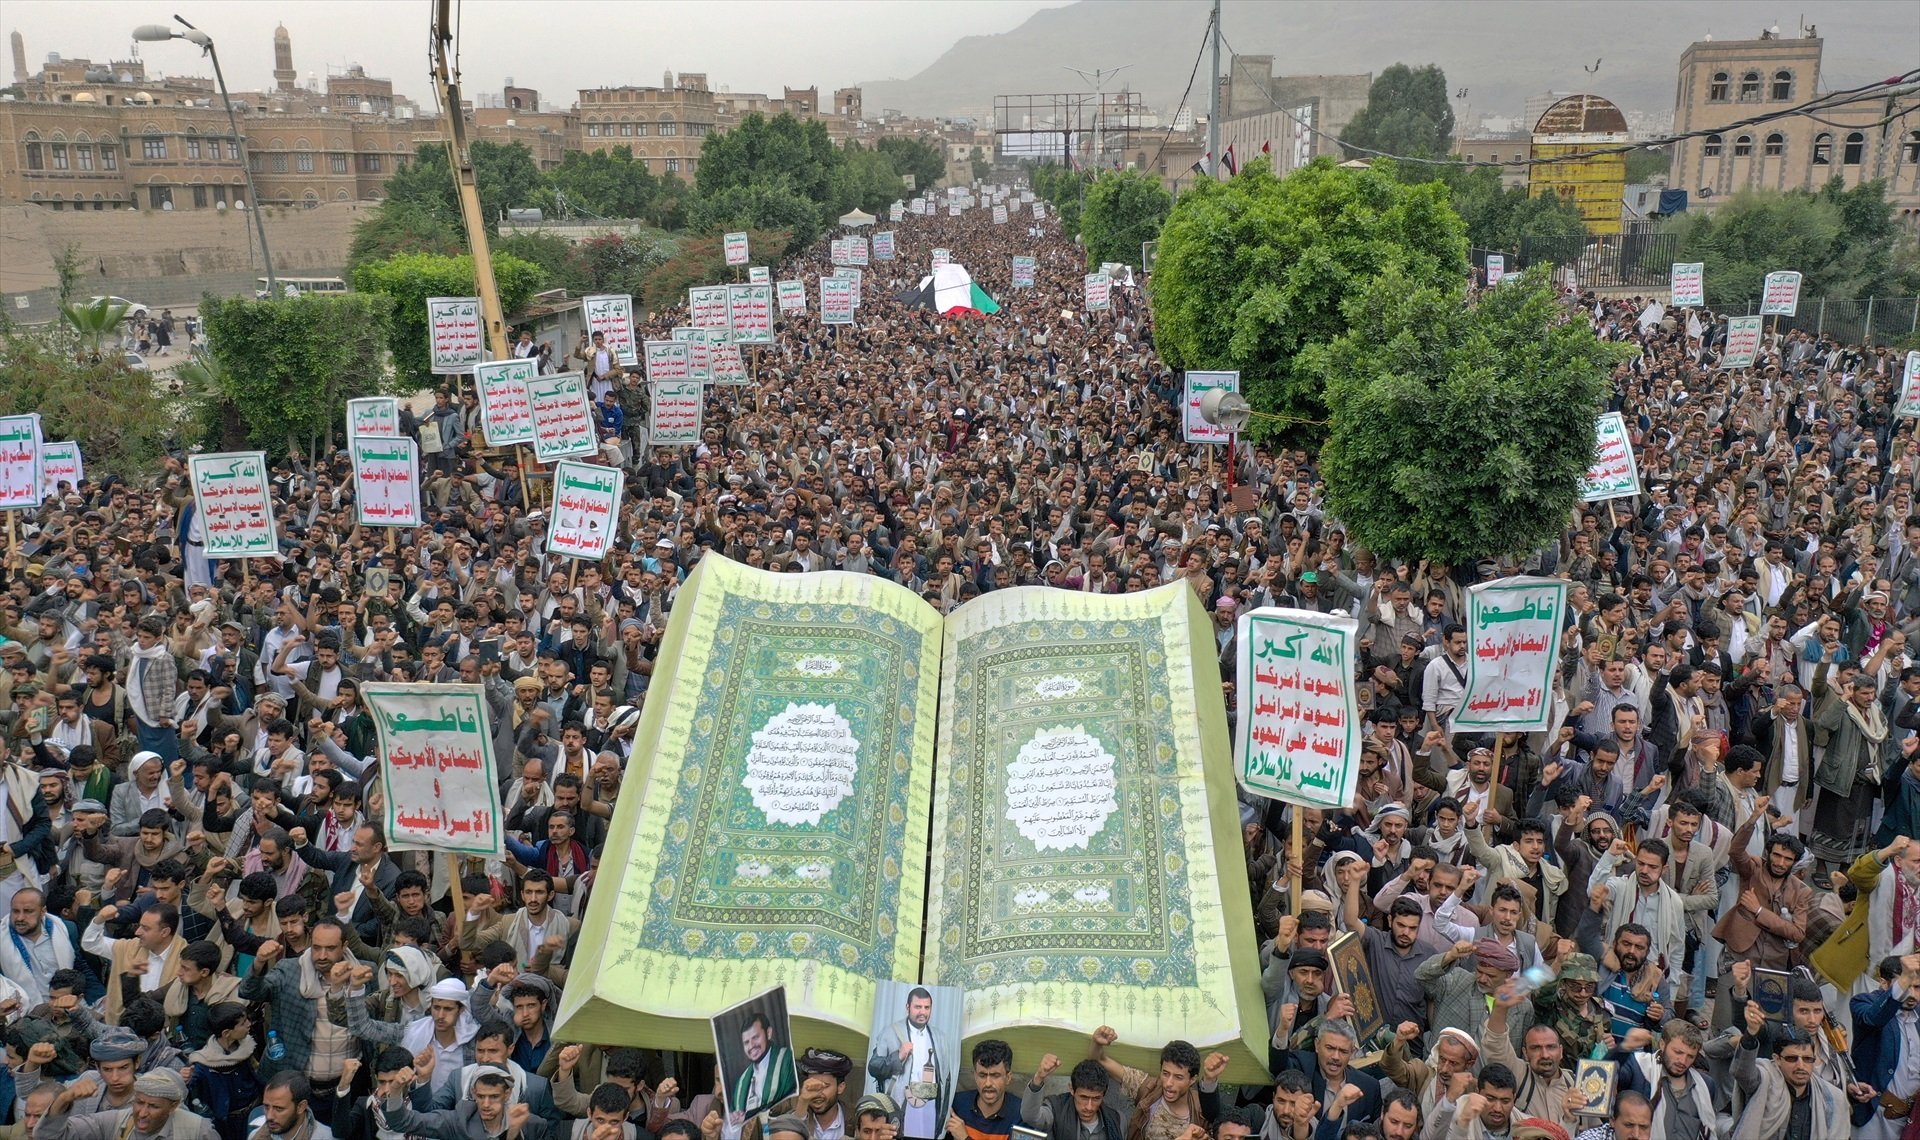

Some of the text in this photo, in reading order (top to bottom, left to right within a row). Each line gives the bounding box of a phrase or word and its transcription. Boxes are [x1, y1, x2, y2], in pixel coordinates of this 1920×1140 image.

[358, 446, 408, 463] قاطعوا
[562, 471, 613, 493] قاطعوا
[1476, 596, 1553, 630] قاطعوا
[1255, 628, 1339, 666] الله أكبر
[1256, 664, 1343, 697] الموت لأمريكا
[1255, 694, 1344, 728] الموت لإسرائيل
[1468, 688, 1541, 712] الإسرائيلية
[377, 706, 477, 736] قاطعوا
[389, 740, 482, 773] البضائع الأمريكية
[1252, 725, 1343, 758] اللعنة على اليهود
[1249, 751, 1339, 791] النصر للإسلام
[434, 778, 440, 798] و
[397, 805, 490, 838] الإسرائيلية
